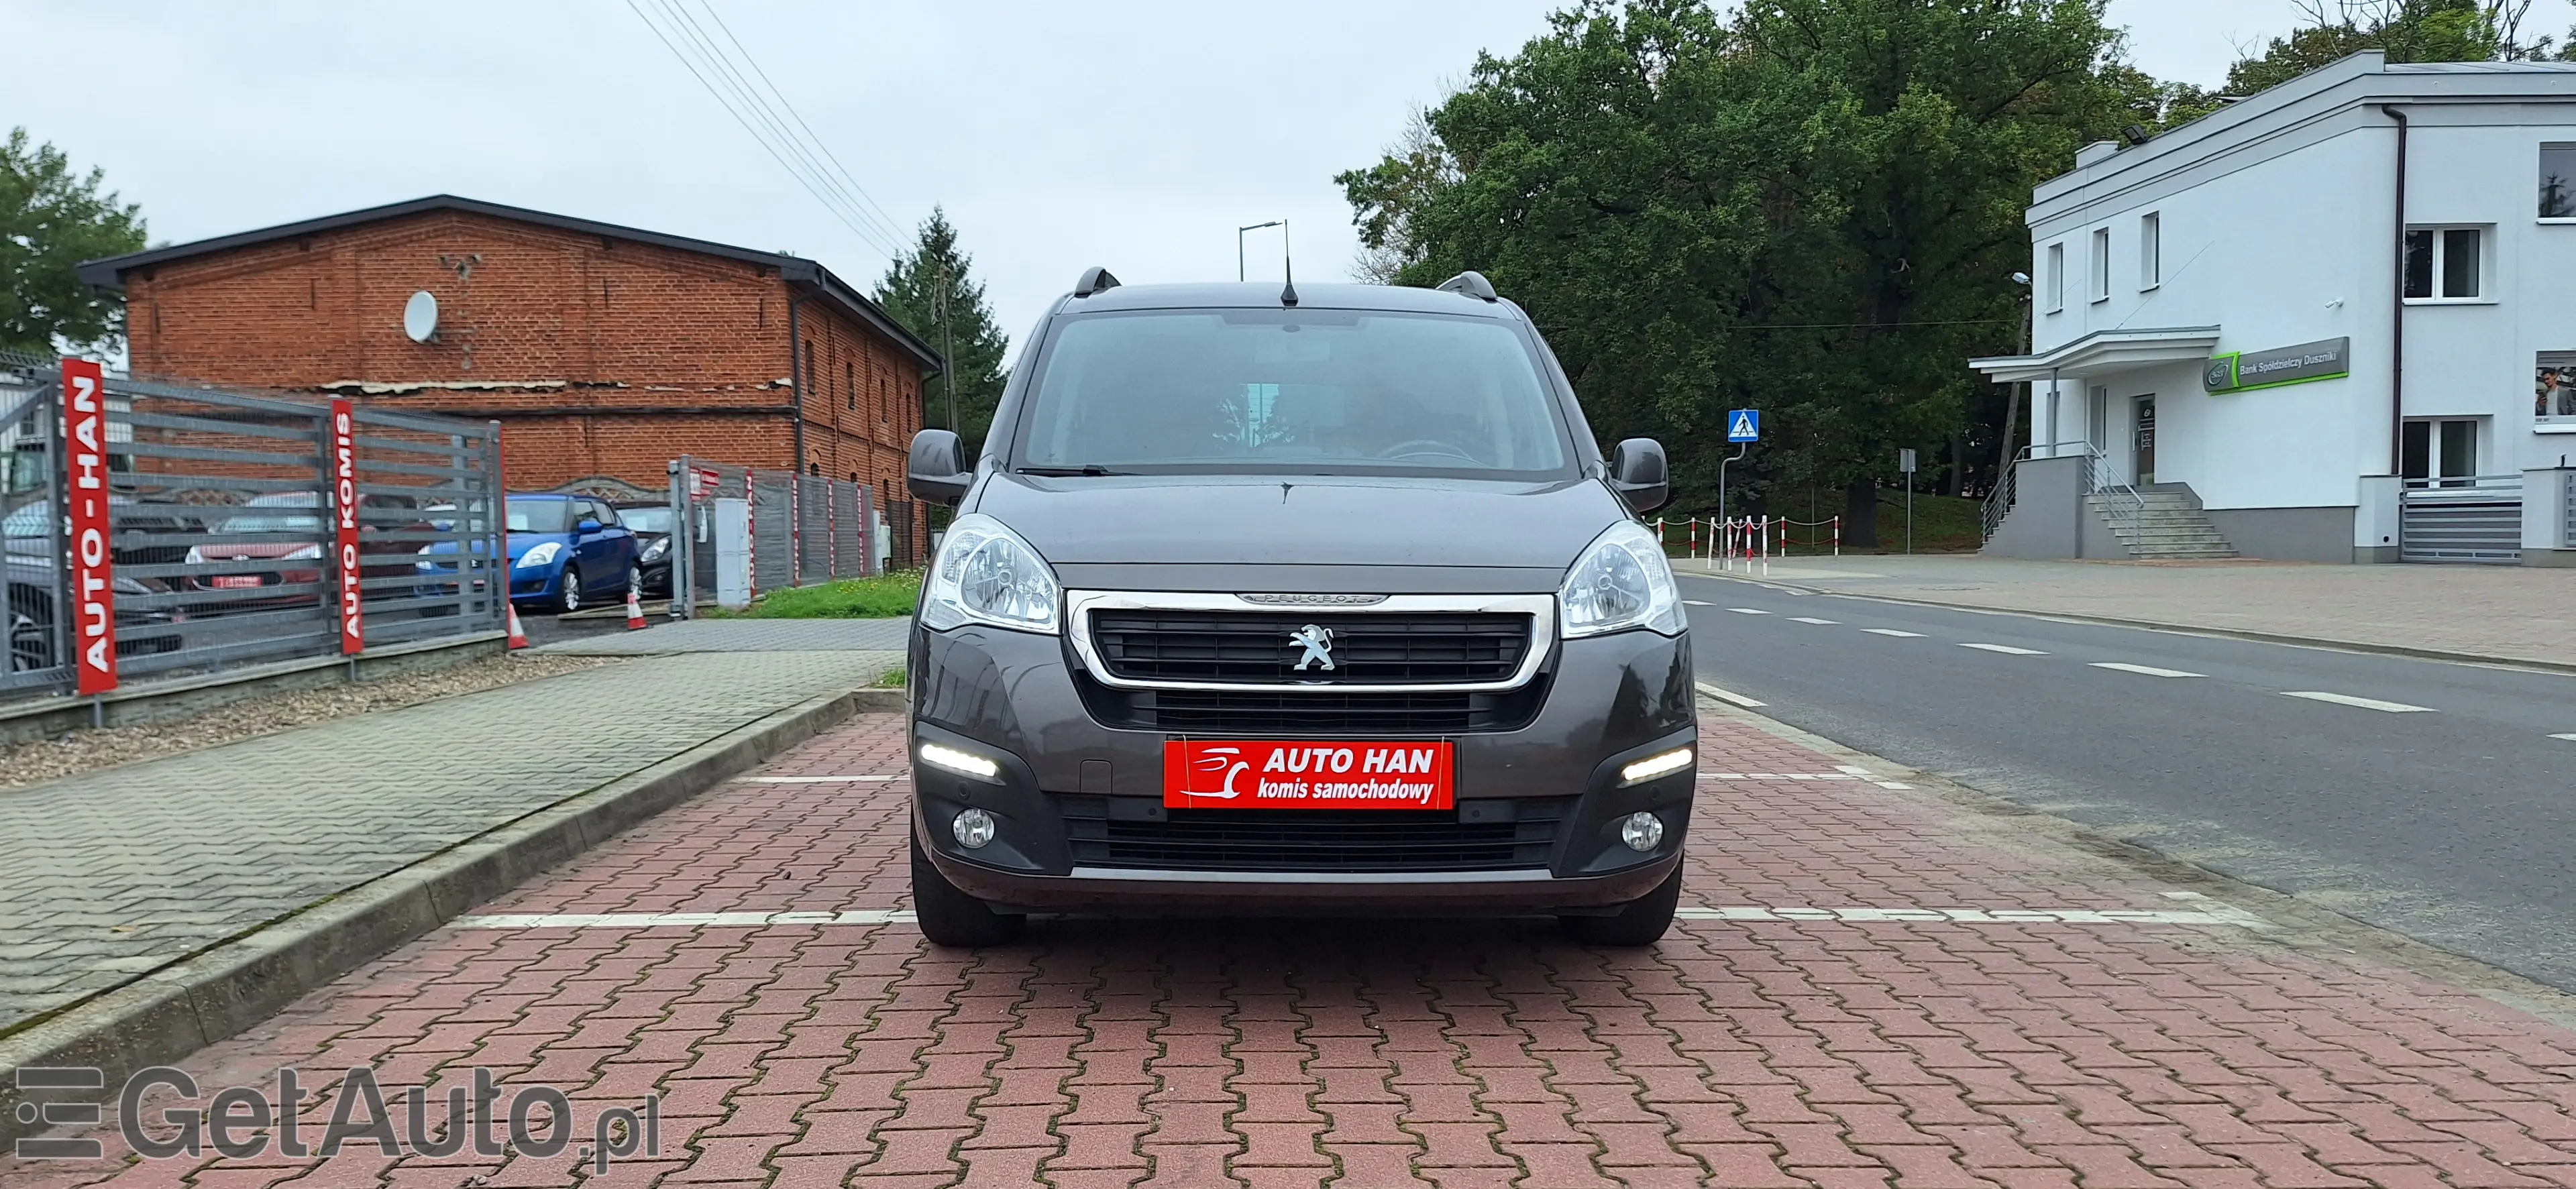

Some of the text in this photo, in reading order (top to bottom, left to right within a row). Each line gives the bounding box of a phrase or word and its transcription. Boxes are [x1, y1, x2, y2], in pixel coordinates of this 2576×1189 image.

[2240, 351, 2337, 376] Bank Spółdzielczy Duszniki
[72, 376, 100, 490] HAN
[336, 412, 360, 638] AUTO KOMIS
[82, 528, 108, 673] AUTO
[1264, 595, 1359, 604] PEUGEOT
[1263, 747, 1434, 774] AUTO HAN
[1256, 777, 1434, 805] komis samochodowy
